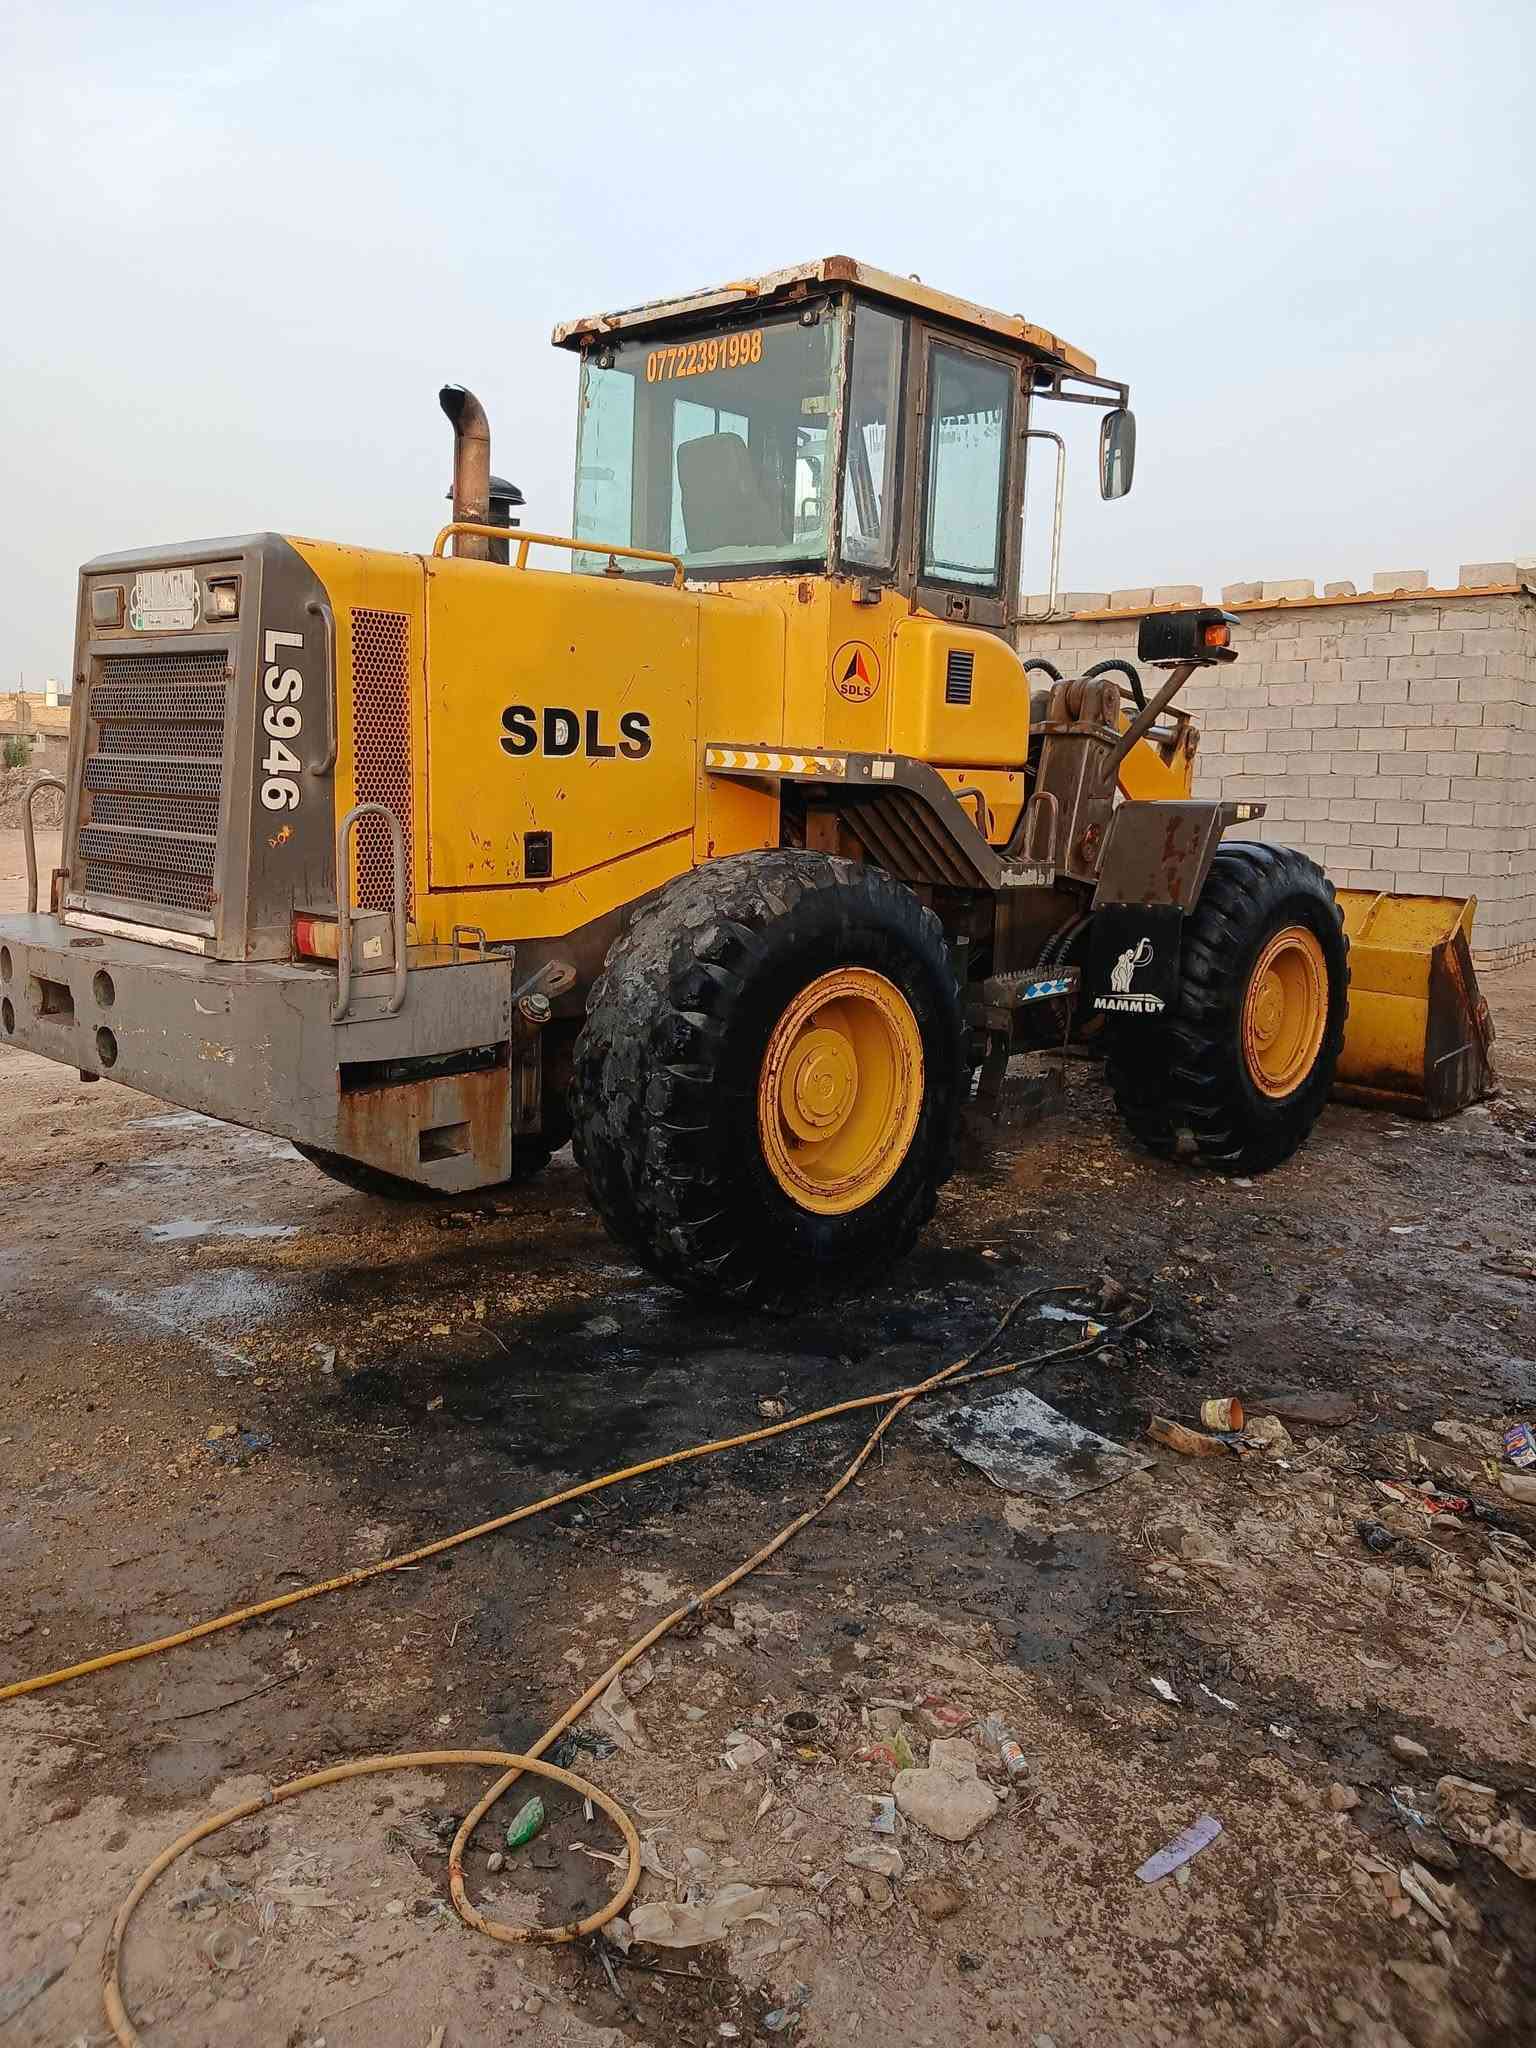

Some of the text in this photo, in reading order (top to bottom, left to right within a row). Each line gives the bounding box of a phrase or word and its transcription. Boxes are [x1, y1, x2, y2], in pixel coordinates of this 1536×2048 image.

[646, 328, 763, 383] 07722391998
[840, 683, 871, 697] SDLS
[260, 629, 304, 812] LS946
[499, 704, 652, 760] SDLS
